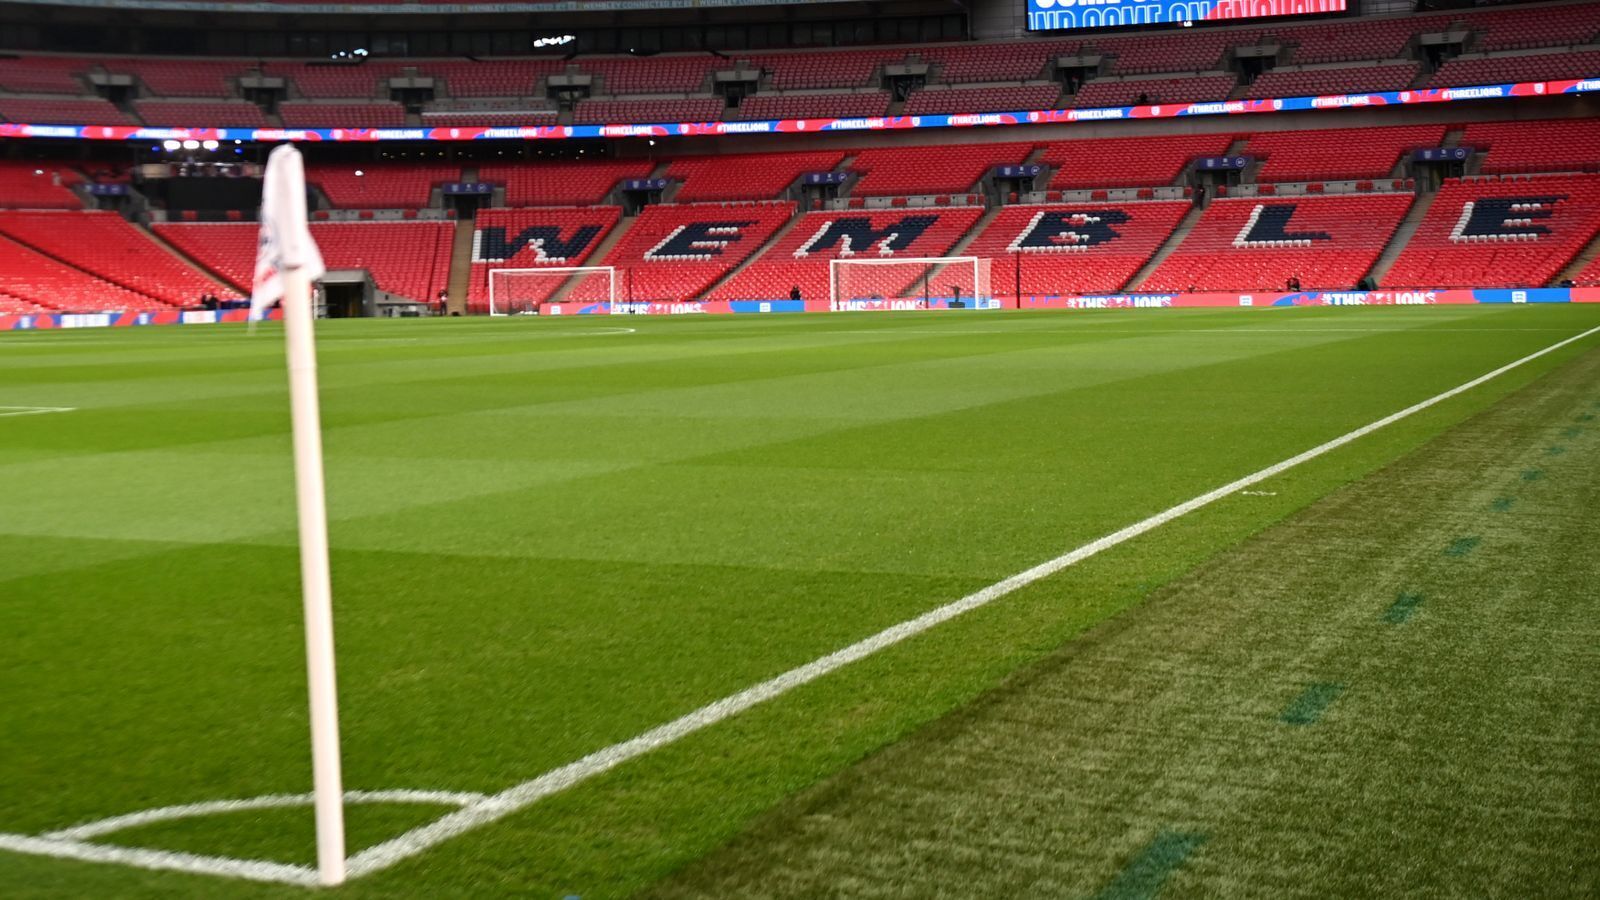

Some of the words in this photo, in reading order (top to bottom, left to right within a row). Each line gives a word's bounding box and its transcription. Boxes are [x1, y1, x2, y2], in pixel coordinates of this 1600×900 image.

[1442, 87, 1502, 99] #THREELIONS
[1312, 95, 1369, 107] #THREELIONS
[1187, 102, 1244, 114] #THREELIONS
[947, 114, 1000, 125] #THREELIONS
[1068, 109, 1122, 120] #THREELIONS
[717, 122, 769, 133] #THREELIONS
[831, 118, 883, 129] #THREELIONS
